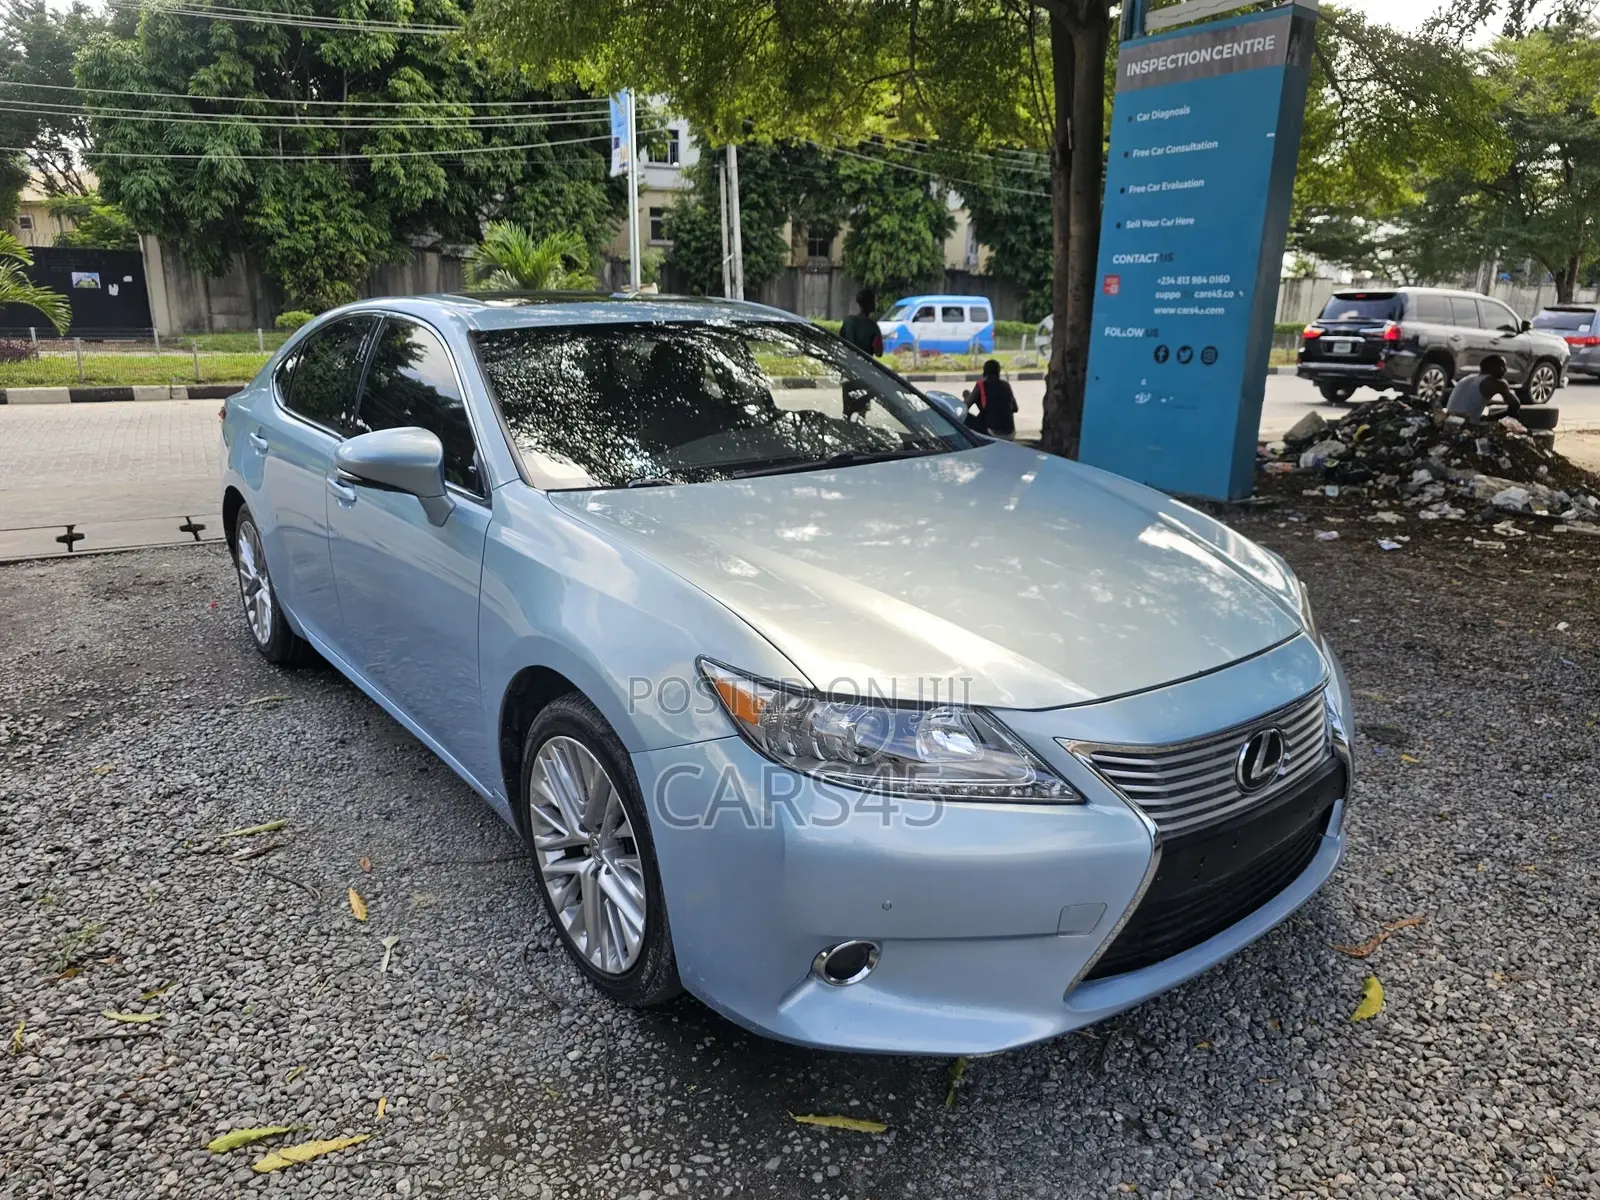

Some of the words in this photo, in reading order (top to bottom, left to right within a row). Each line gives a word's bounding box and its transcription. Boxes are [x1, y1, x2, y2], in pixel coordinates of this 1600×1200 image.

[1126, 47, 1211, 77] INSPECTION
[1212, 34, 1276, 61] CENTRE
[1136, 112, 1150, 122] Car
[1151, 104, 1191, 120] Diagnosis
[1132, 148, 1149, 158] Free
[1150, 147, 1165, 156] Car
[1165, 140, 1219, 154] Consultation
[1128, 184, 1146, 194] Free
[1147, 183, 1160, 192] Car
[1161, 178, 1205, 191] Evaluation
[1126, 219, 1140, 229] Sell
[1141, 218, 1160, 228] Your
[1160, 217, 1174, 227] Car
[1175, 216, 1195, 226] Here
[1112, 252, 1159, 265] CONTACT
[1176, 275, 1190, 285] 813
[1208, 274, 1231, 284] 0160
